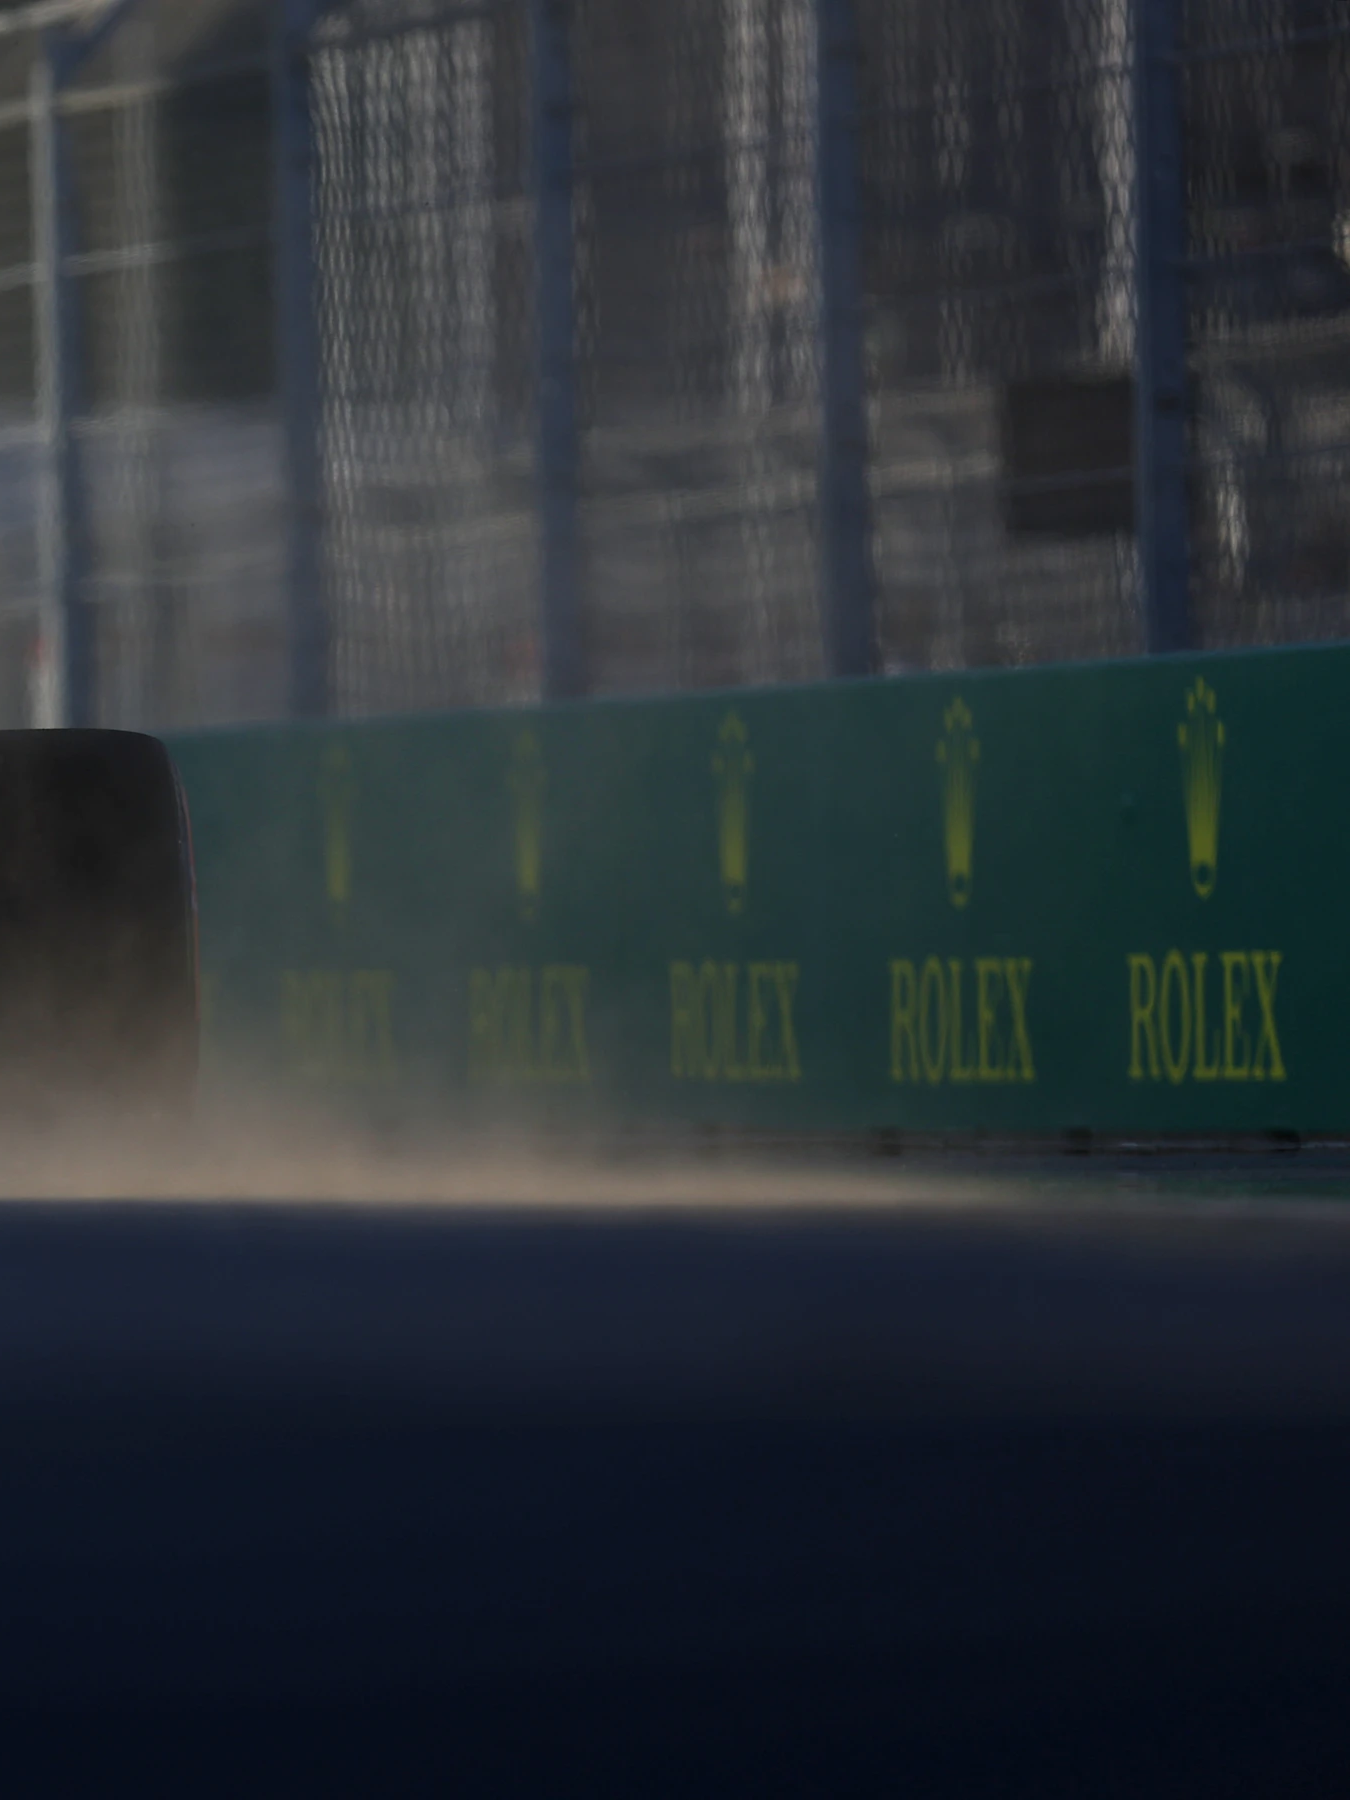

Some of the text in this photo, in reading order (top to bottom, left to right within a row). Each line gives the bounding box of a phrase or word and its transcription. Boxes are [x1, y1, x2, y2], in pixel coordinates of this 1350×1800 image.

[668, 957, 802, 1081] ROLEX
[889, 953, 1036, 1085] ROLEX
[1127, 948, 1287, 1085] ROLEX
